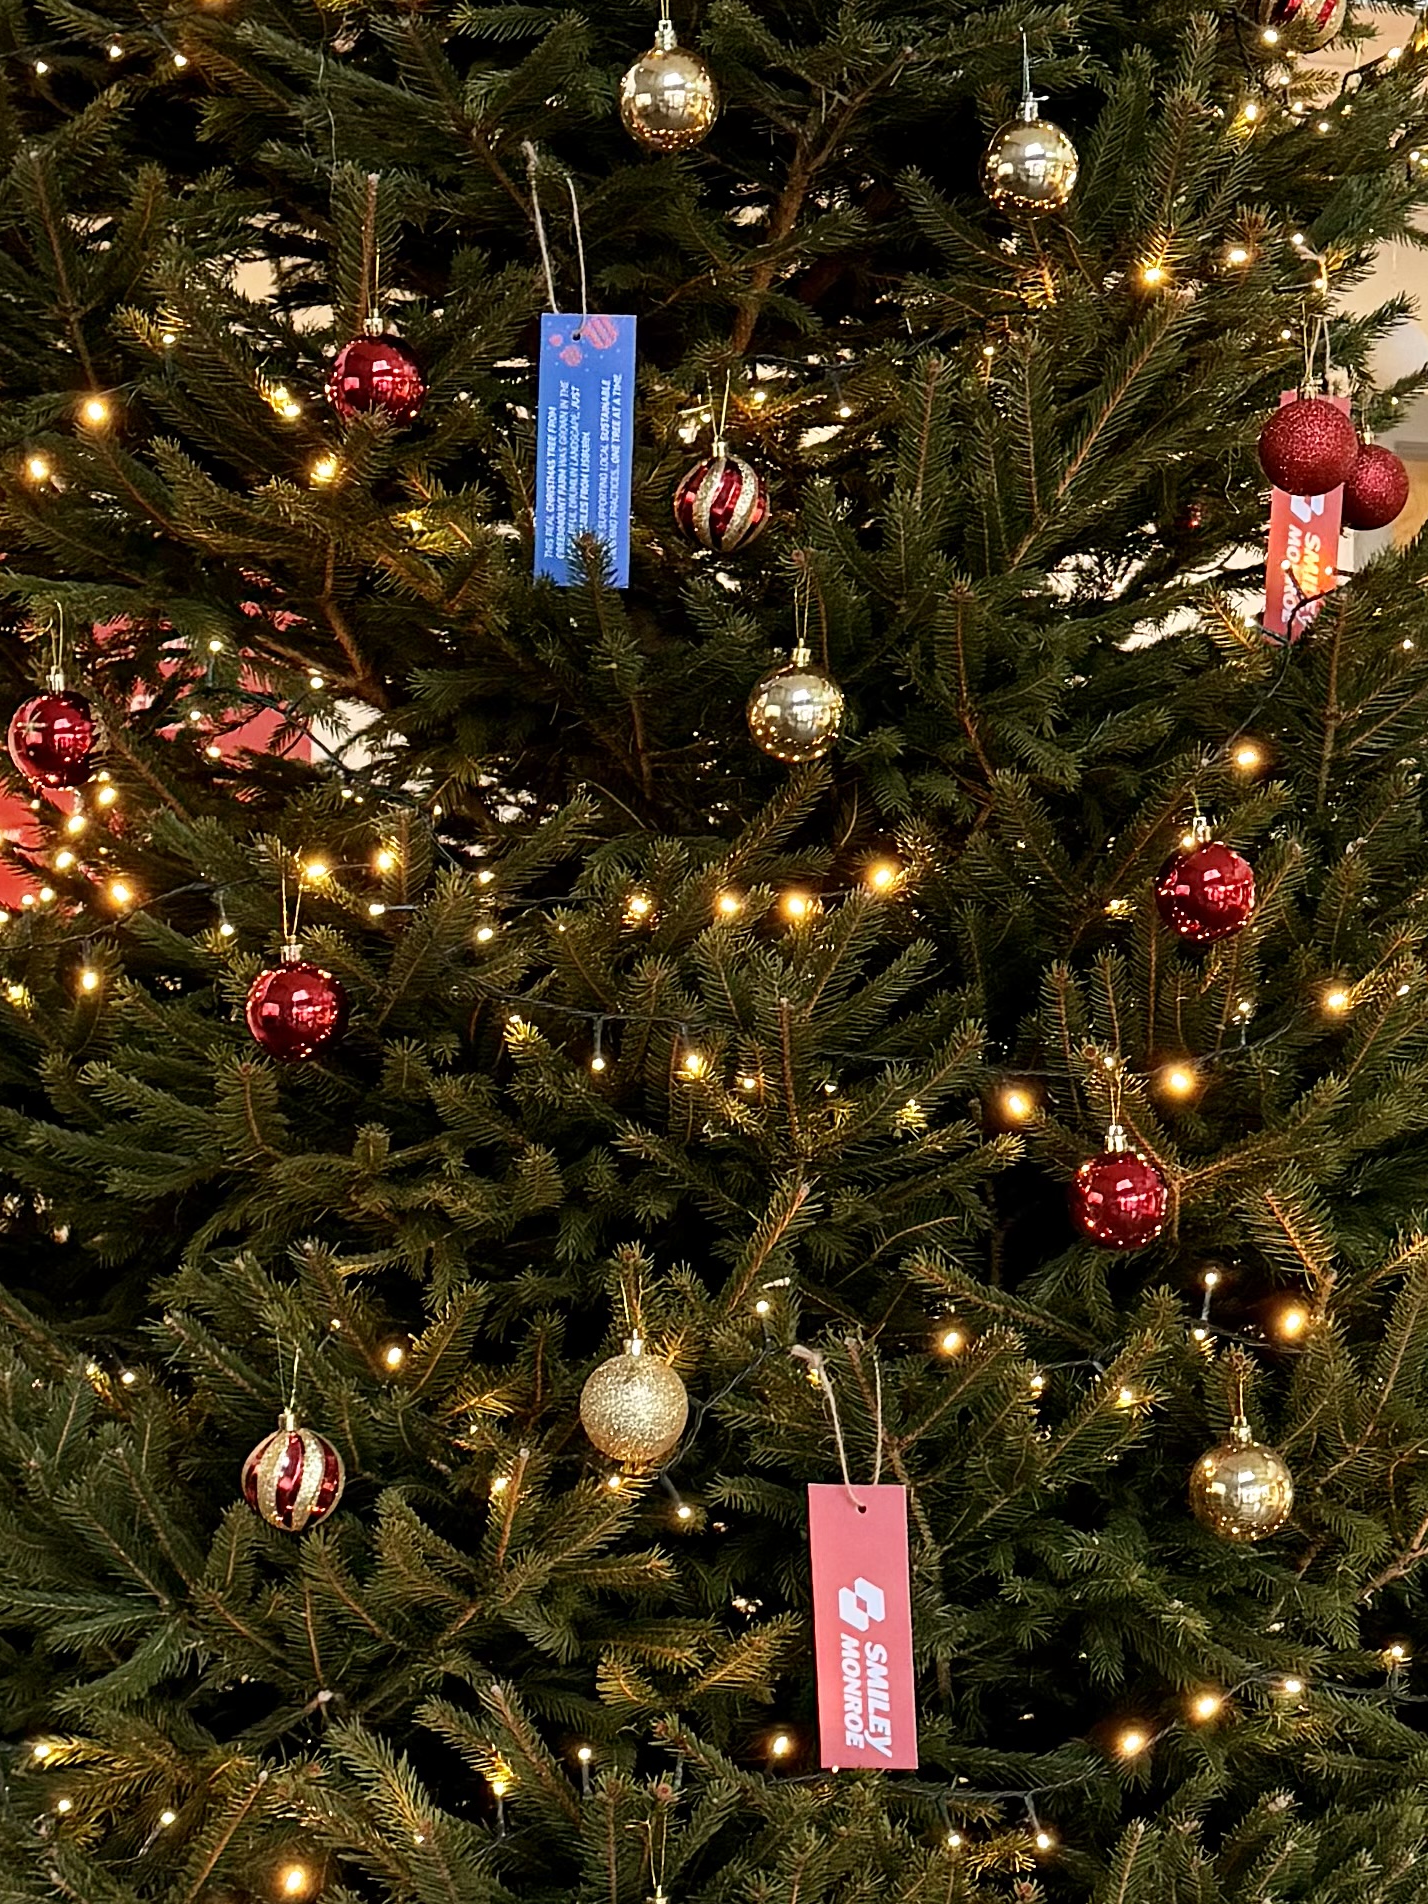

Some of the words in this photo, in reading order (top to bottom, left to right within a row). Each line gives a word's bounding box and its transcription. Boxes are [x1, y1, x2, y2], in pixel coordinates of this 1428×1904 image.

[570, 385, 580, 409] JUST
[599, 378, 611, 441] SUSTAINABLE
[547, 406, 557, 432] FROM
[558, 411, 568, 445] GROWN
[610, 418, 621, 442] TREE
[546, 434, 556, 456] TREE
[557, 446, 567, 466] WAS
[598, 443, 609, 471] LOCAL
[545, 459, 555, 512] CHRISTMAS
[556, 468, 566, 494] FARM
[579, 474, 589, 499] FROM
[597, 472, 608, 529] SUPPORTING
[1296, 532, 1322, 625] SMILEY
[840, 1632, 865, 1750] MONROE
[864, 1641, 893, 1758] SMILEY
